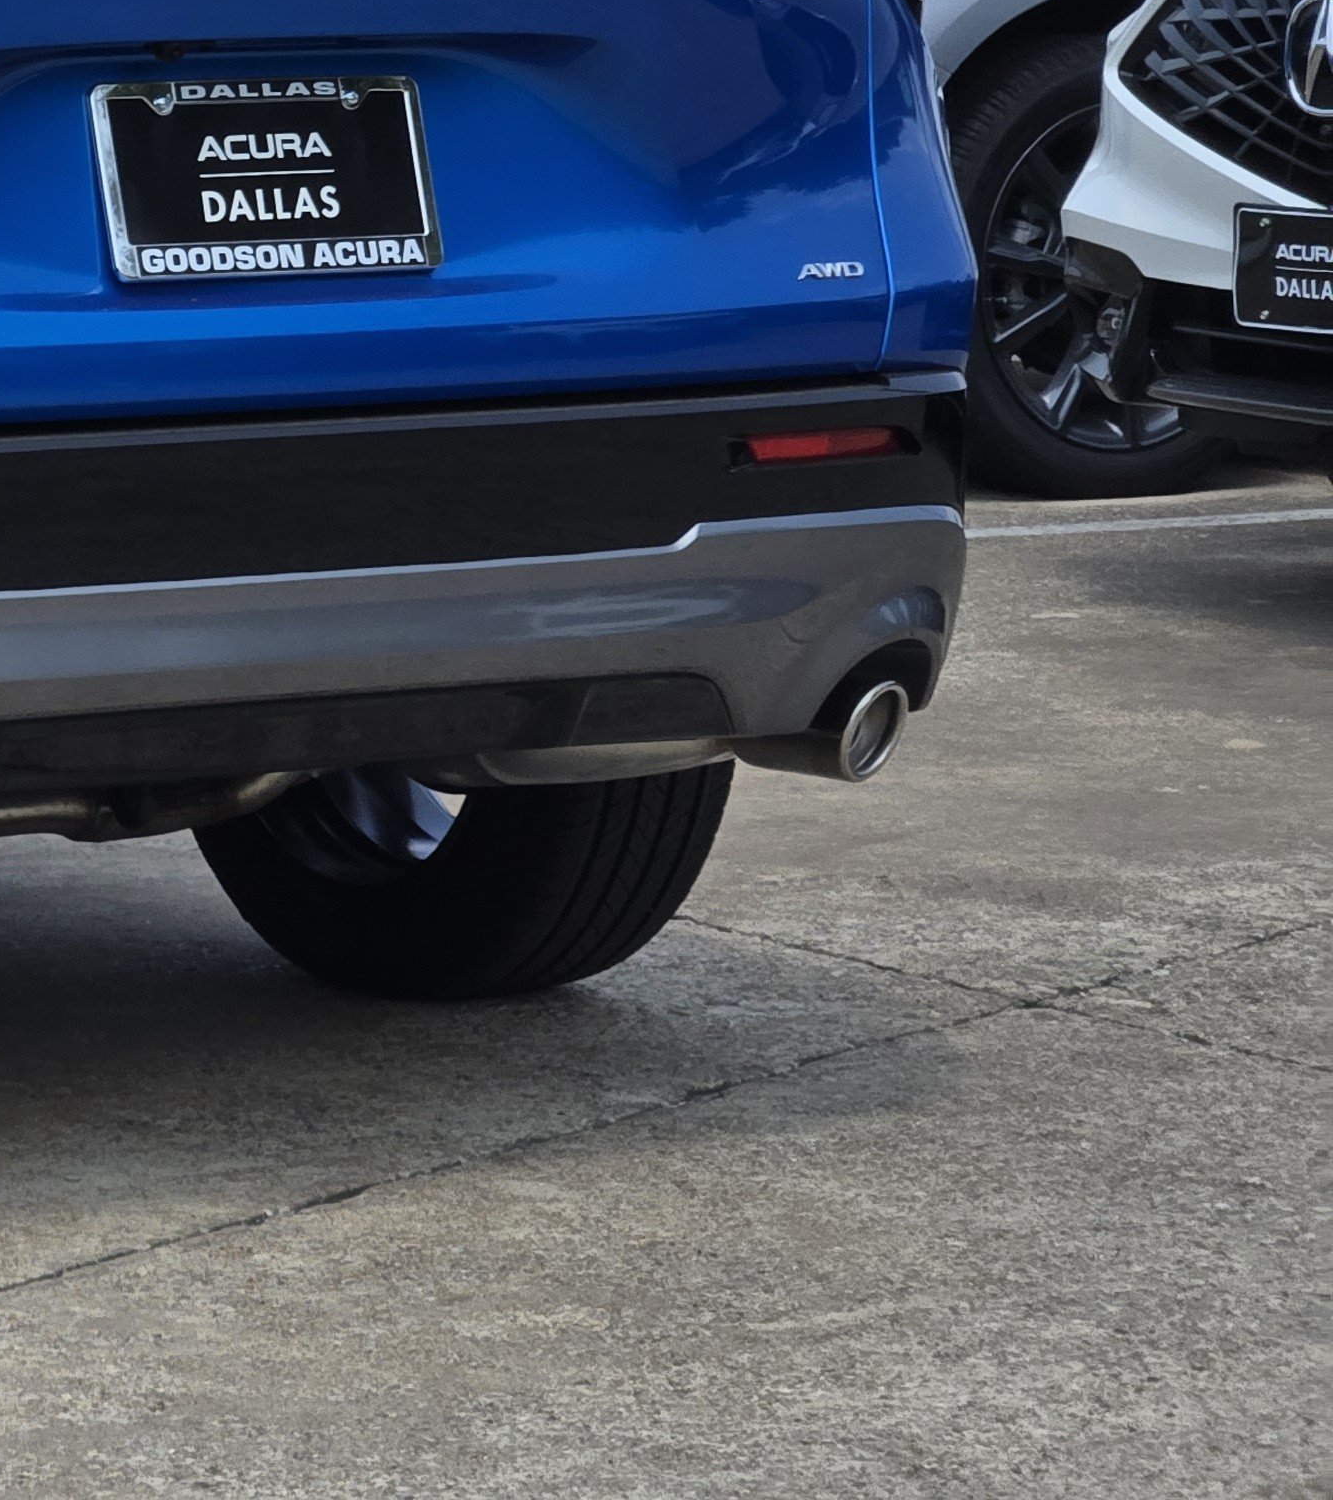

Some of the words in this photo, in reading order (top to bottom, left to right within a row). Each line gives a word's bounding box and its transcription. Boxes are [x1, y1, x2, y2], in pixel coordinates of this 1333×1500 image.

[180, 81, 337, 100] DALLAS
[197, 132, 332, 161] ACURA
[201, 185, 341, 222] DALLAS
[140, 243, 305, 273] GOODSON
[313, 238, 425, 267] ACURA
[797, 261, 864, 281] AWD
